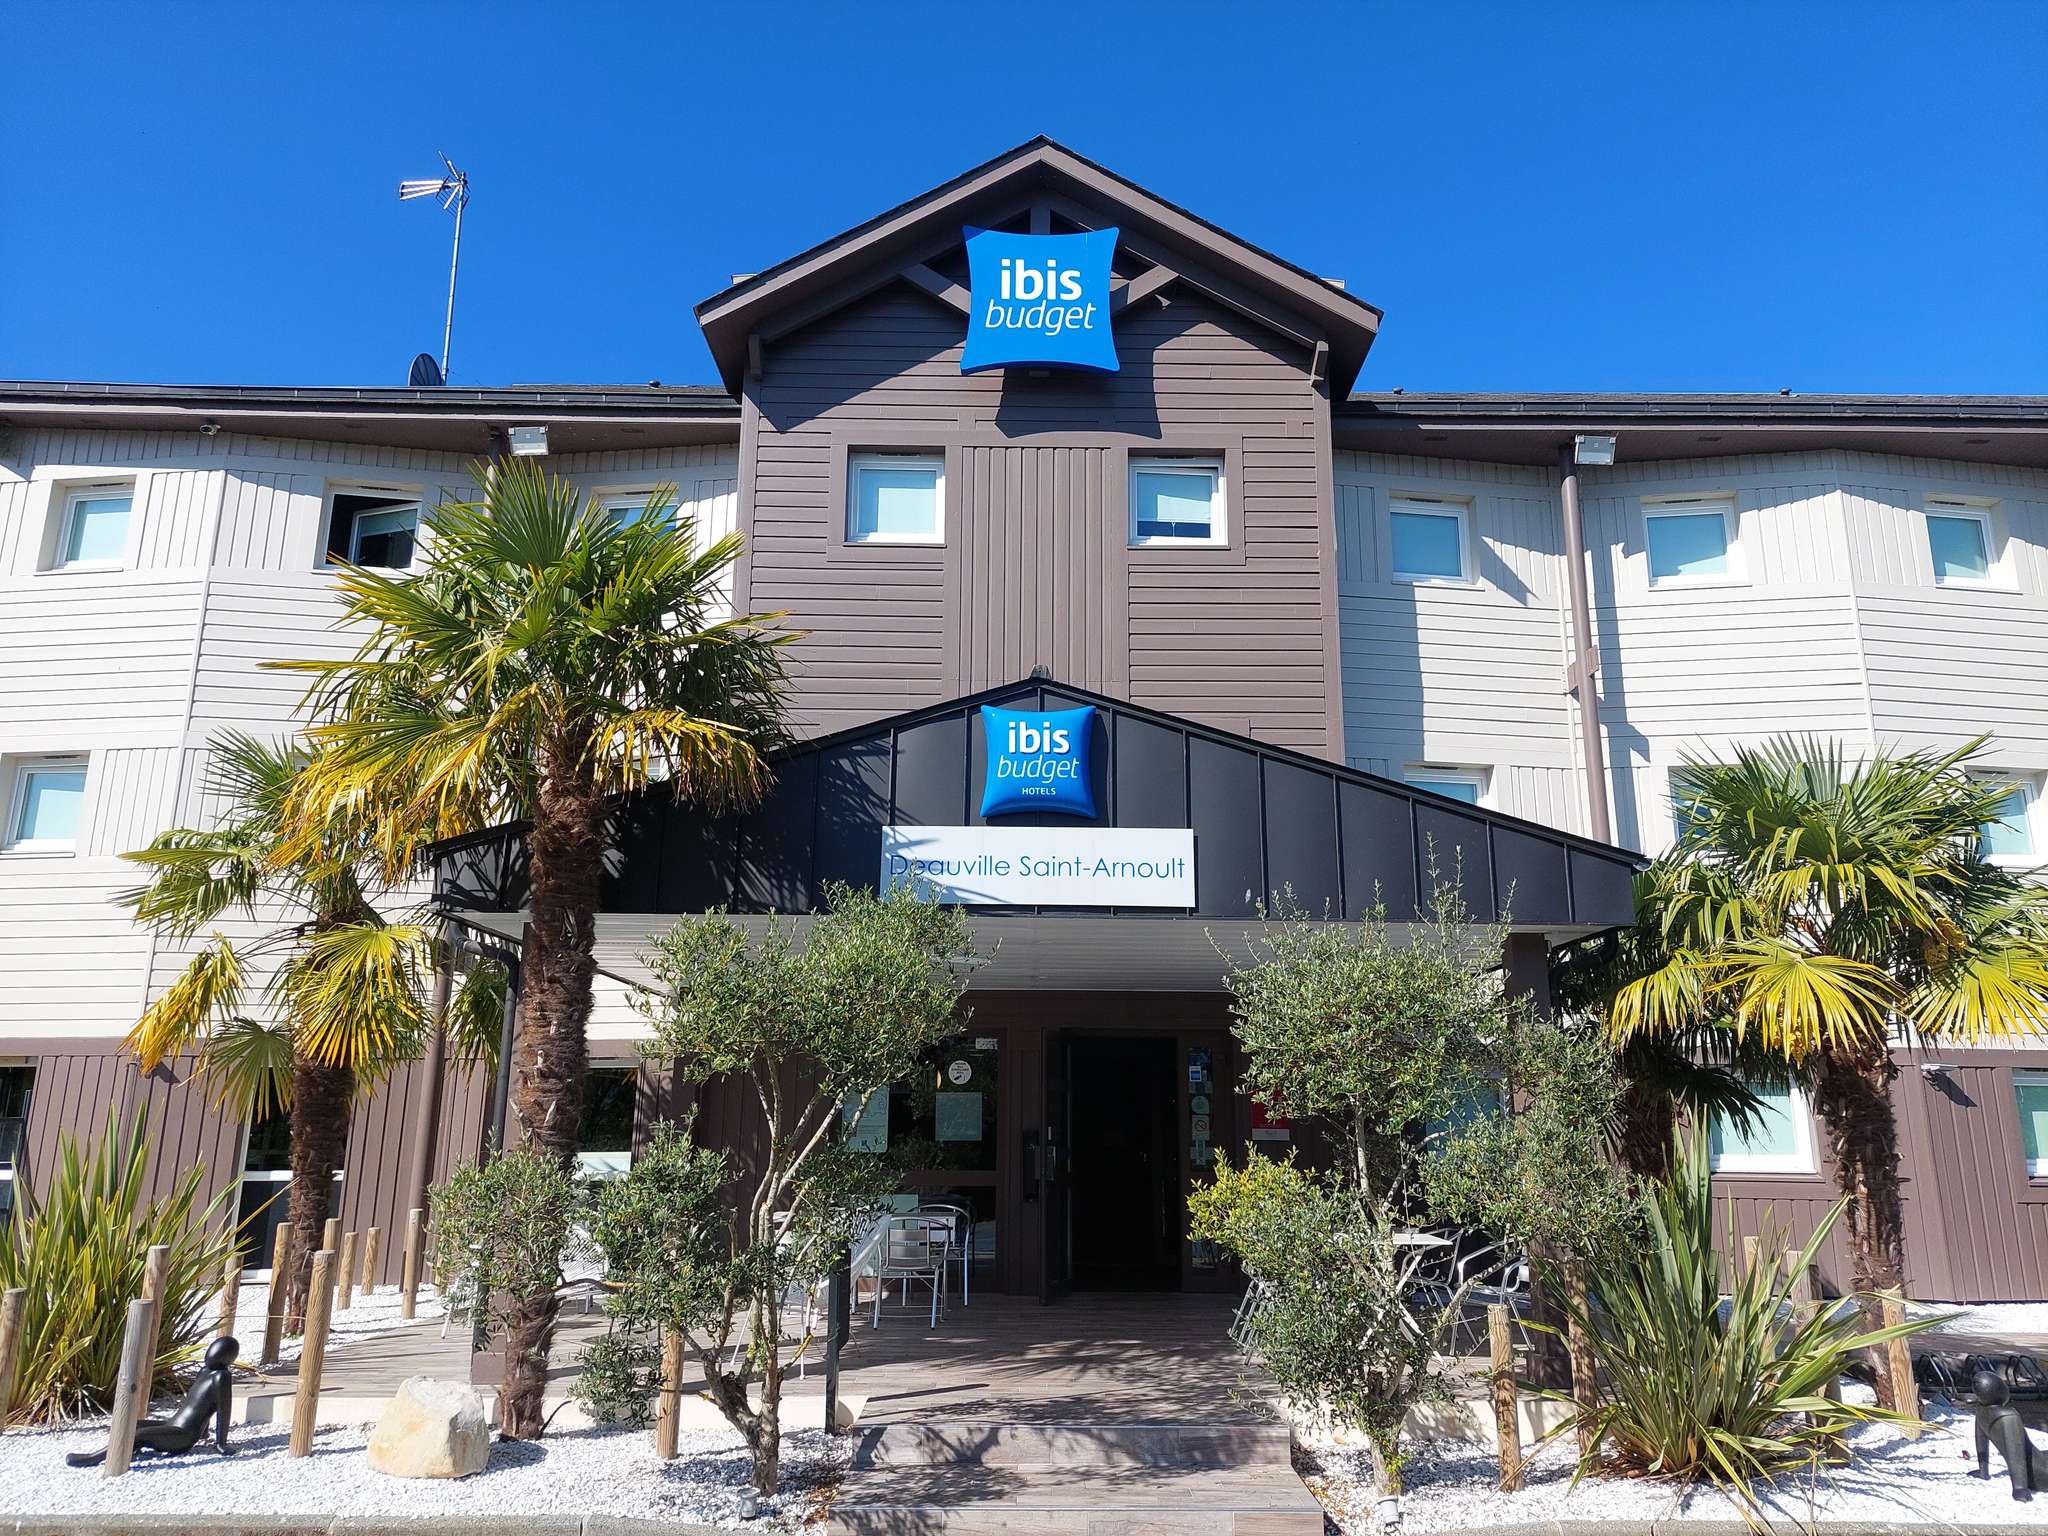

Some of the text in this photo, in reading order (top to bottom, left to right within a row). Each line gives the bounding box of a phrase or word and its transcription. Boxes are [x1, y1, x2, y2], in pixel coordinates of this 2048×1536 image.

[1001, 258, 1082, 300] ibis
[985, 299, 1097, 336] budget
[1008, 721, 1071, 754] ibis
[996, 754, 1080, 784] budget
[1022, 787, 1056, 796] HOTELS
[889, 854, 1185, 879] Deauville Saint-Arnoult
